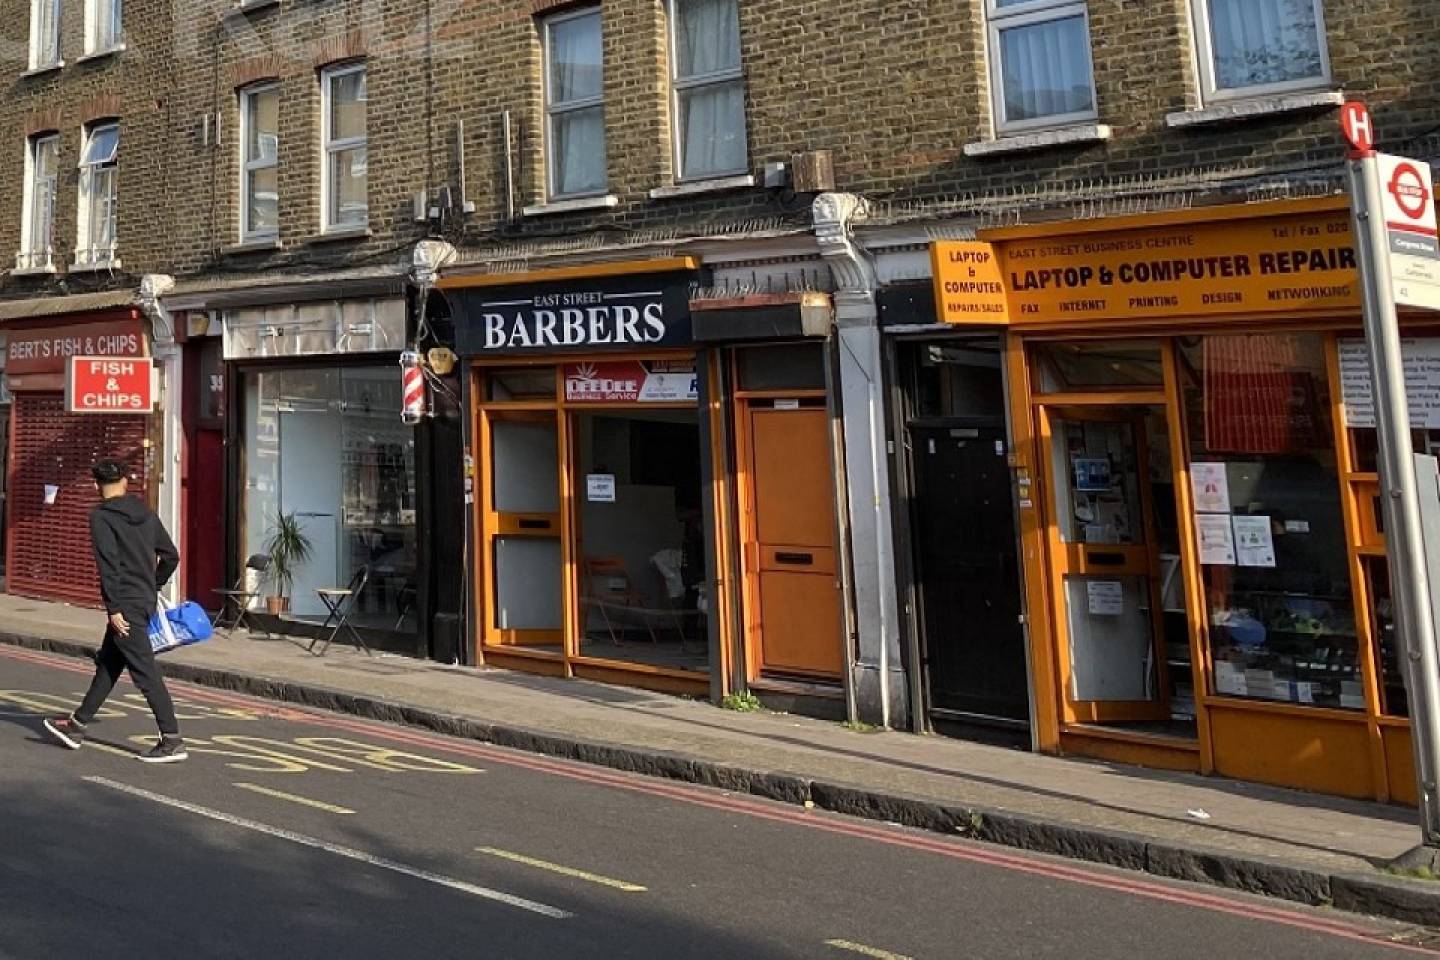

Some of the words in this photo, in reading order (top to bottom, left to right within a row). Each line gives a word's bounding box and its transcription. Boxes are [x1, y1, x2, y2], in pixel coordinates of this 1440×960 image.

[1349, 107, 1371, 144] H
[1272, 227, 1289, 238] Tel
[1300, 225, 1320, 236] Fax
[1010, 247, 1036, 259] EAST
[1040, 244, 1081, 258] STREET
[1083, 239, 1143, 254] BUSINESS
[1146, 234, 1195, 249] CENTRE
[950, 250, 991, 264] LAPTOP
[1011, 266, 1093, 291] LAPTOP
[1099, 264, 1113, 285] &
[1119, 254, 1251, 284] COMPUTER
[1258, 247, 1358, 274] REPAIR
[944, 281, 1003, 294] COMPUTER
[534, 295, 559, 307] EAST
[563, 292, 602, 306] STREET
[1021, 303, 1040, 315] FAX
[1060, 299, 1106, 313] INTERNET
[1128, 295, 1178, 309] PRINTING
[1202, 292, 1242, 305] DESIGN
[1268, 285, 1351, 301] NETWORKING
[482, 302, 666, 349] BARBERS
[10, 339, 51, 360] BERT'S
[53, 338, 82, 357] FISH
[84, 337, 95, 355] &
[97, 334, 138, 355] CHIPS
[90, 361, 135, 375] FISH
[106, 377, 120, 391] &
[83, 392, 143, 407] CHIPS
